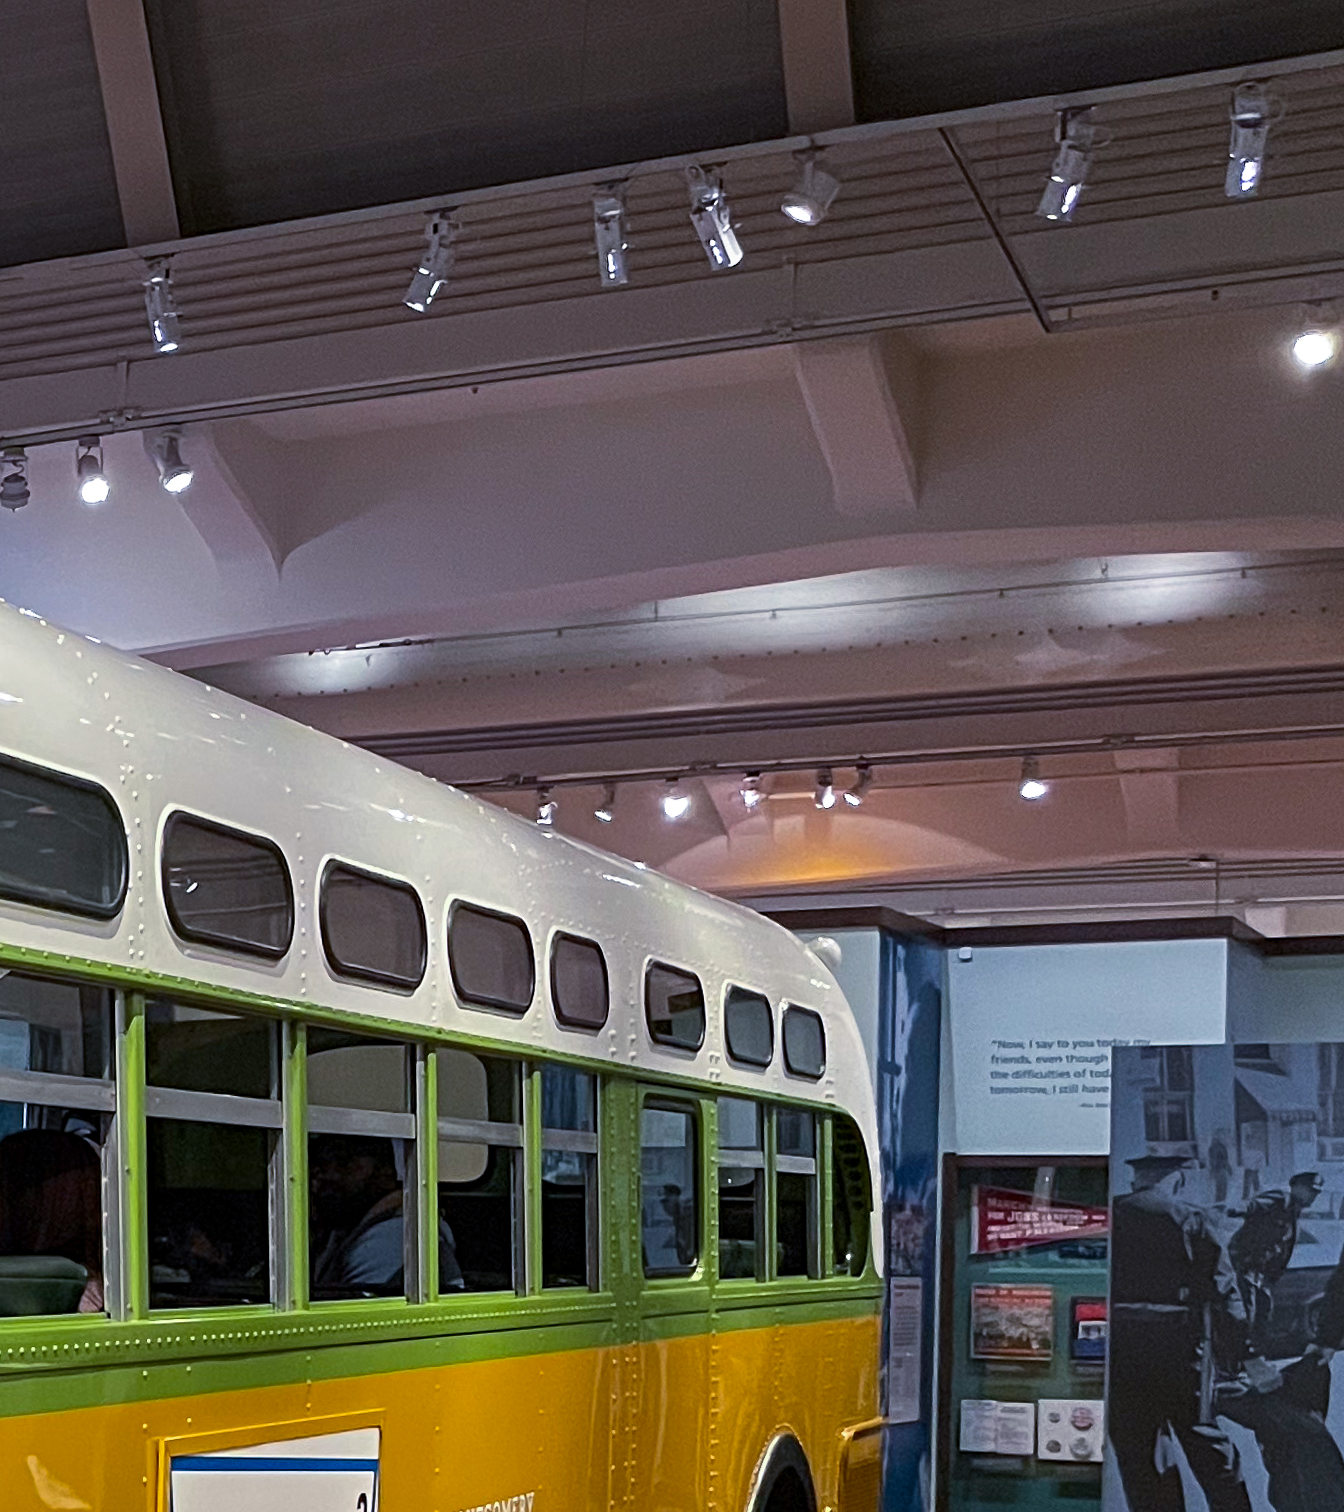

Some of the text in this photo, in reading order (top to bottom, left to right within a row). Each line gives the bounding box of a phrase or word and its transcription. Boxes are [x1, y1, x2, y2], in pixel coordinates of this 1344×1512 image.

[1035, 1041, 1054, 1050] say
[1057, 1040, 1069, 1048] to
[1072, 1041, 1094, 1050] you
[1036, 1056, 1062, 1064] even
[1065, 1054, 1108, 1065] though
[990, 1069, 1010, 1079] the
[1011, 1069, 1071, 1079] difficulties
[1073, 1069, 1086, 1078] of
[1059, 1085, 1079, 1094] still
[1081, 1085, 1109, 1093] have
